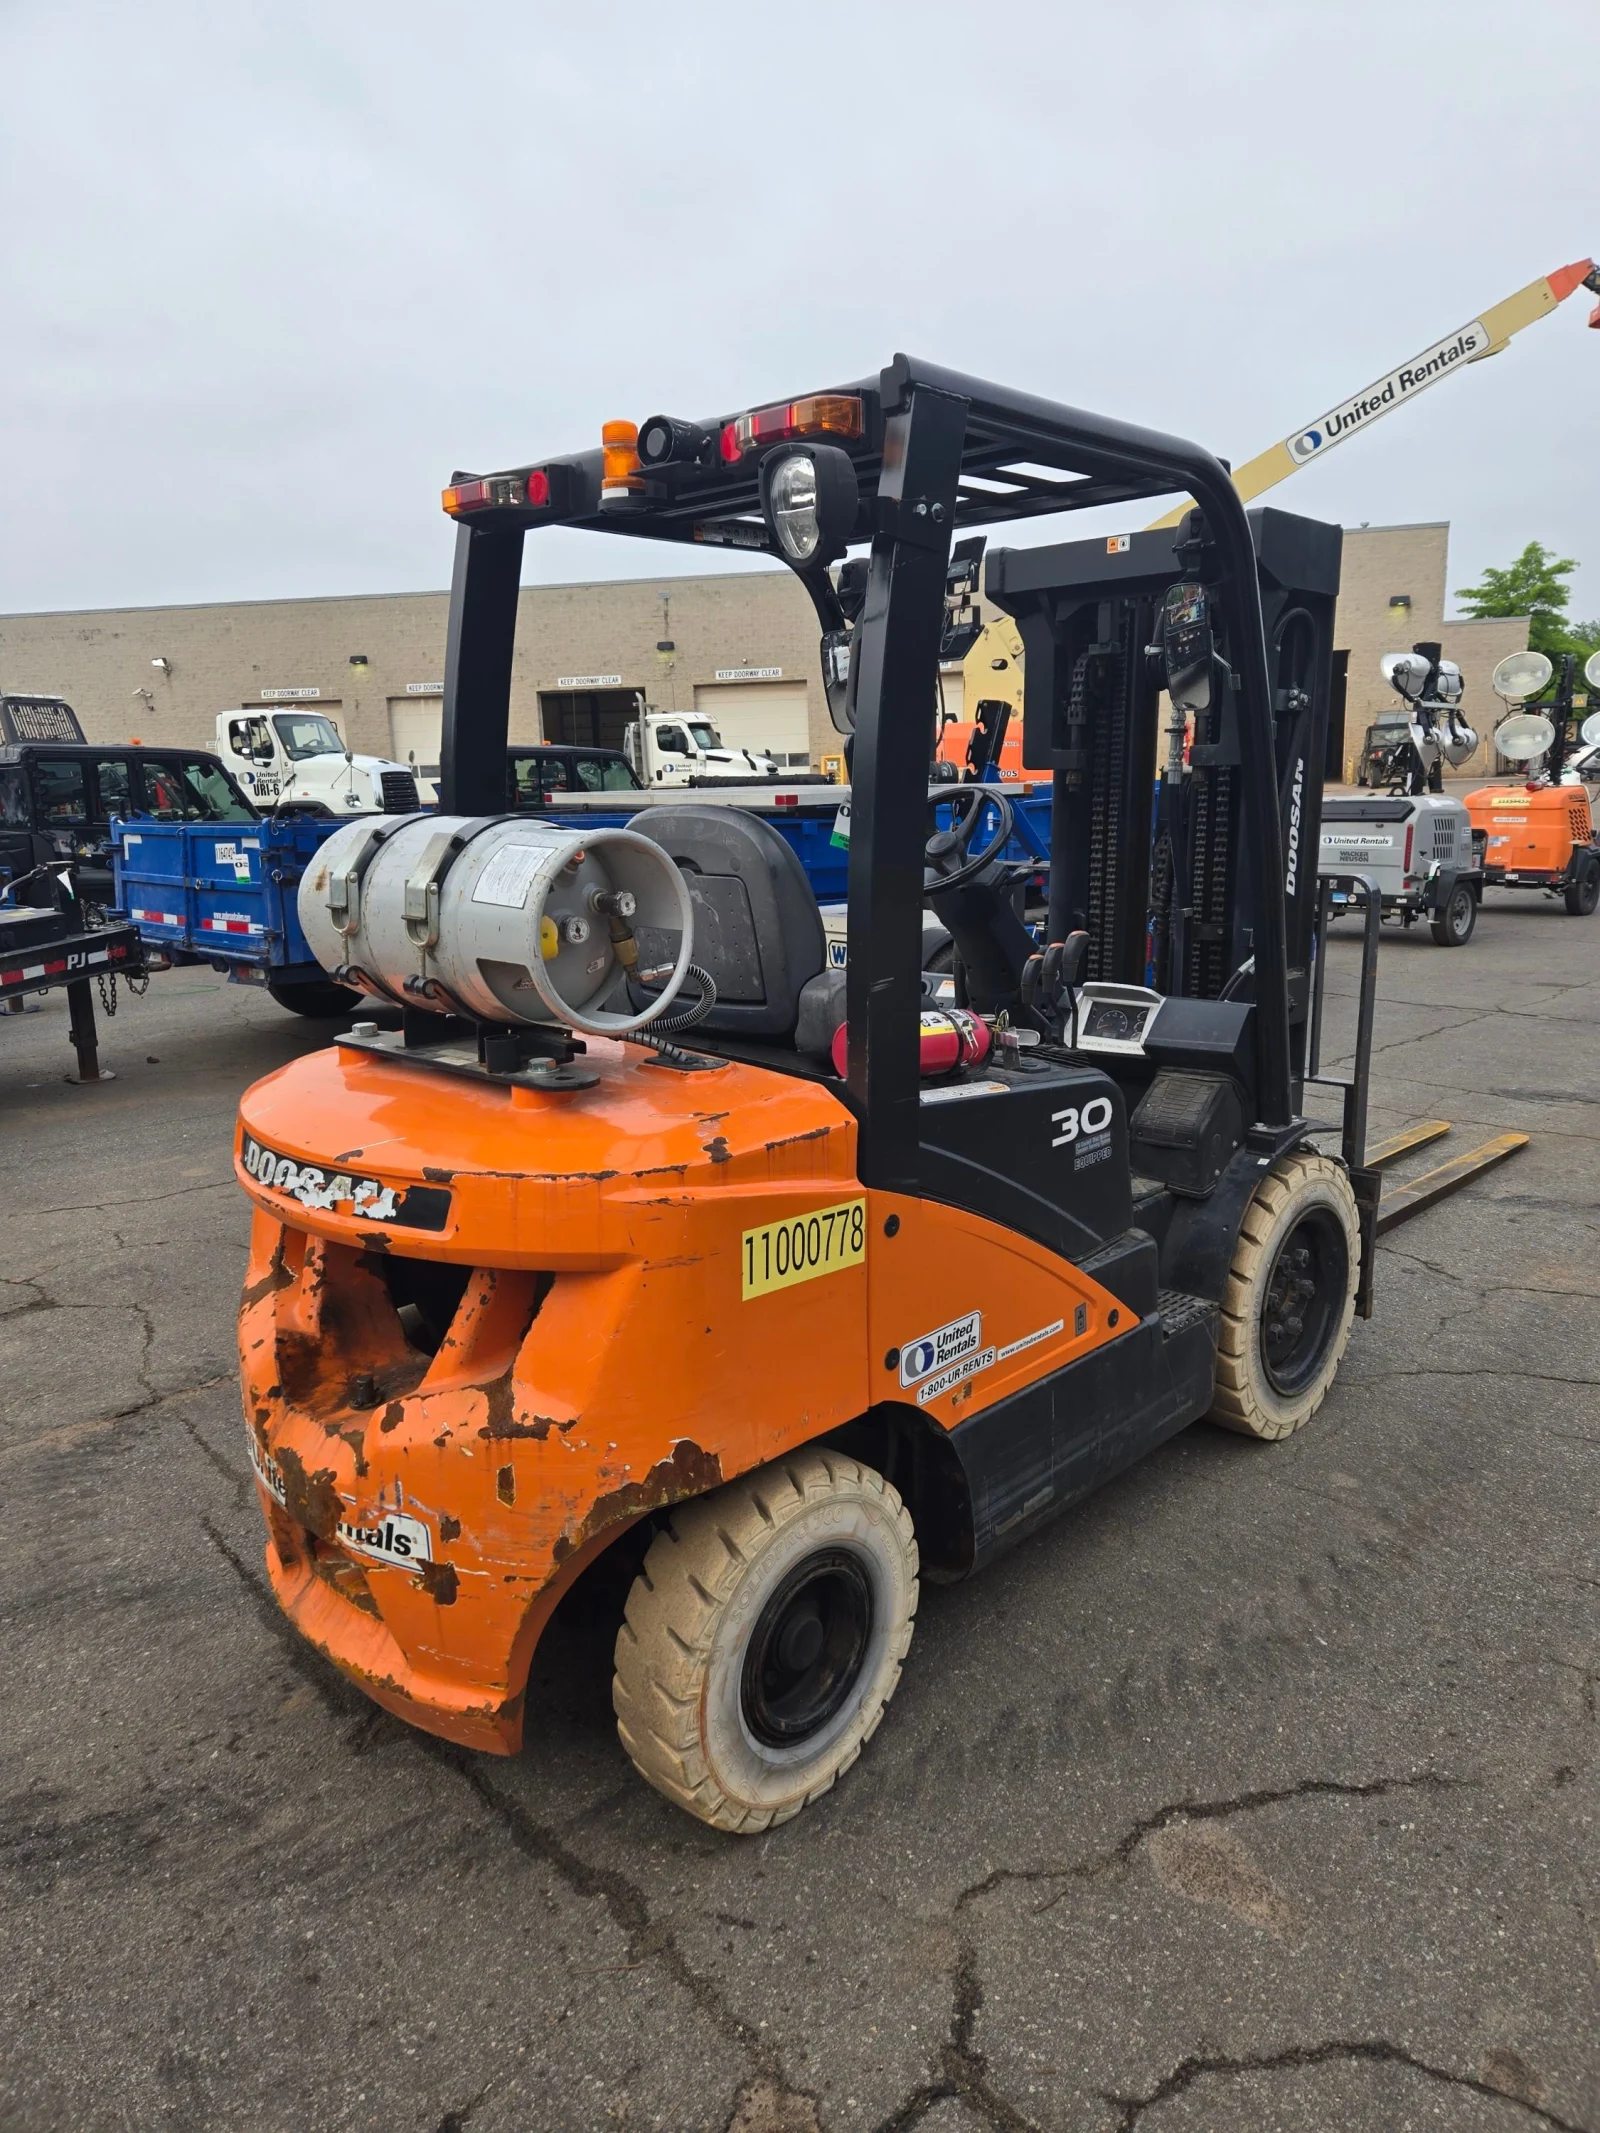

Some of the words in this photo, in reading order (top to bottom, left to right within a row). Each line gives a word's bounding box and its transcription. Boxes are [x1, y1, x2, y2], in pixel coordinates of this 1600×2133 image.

[1325, 382, 1395, 437] United
[1399, 335, 1477, 392] Rentals
[277, 689, 300, 697] DOORWAY
[575, 677, 599, 685] DOORWAY
[253, 783, 280, 797] URI-6
[1286, 758, 1304, 896] DOOSAN
[1333, 836, 1359, 844] United
[1360, 837, 1389, 845] Rentals
[67, 952, 86, 970] PJ
[1051, 1097, 1113, 1148] 30
[1074, 1146, 1112, 1171] EQUIPPED
[745, 1205, 863, 1285] 11000778
[936, 1318, 975, 1348] United
[936, 1335, 976, 1365] Rentals
[920, 1351, 993, 1400] 1-800-UR-RENTS
[730, 1521, 809, 1625] SOLIDPRO
